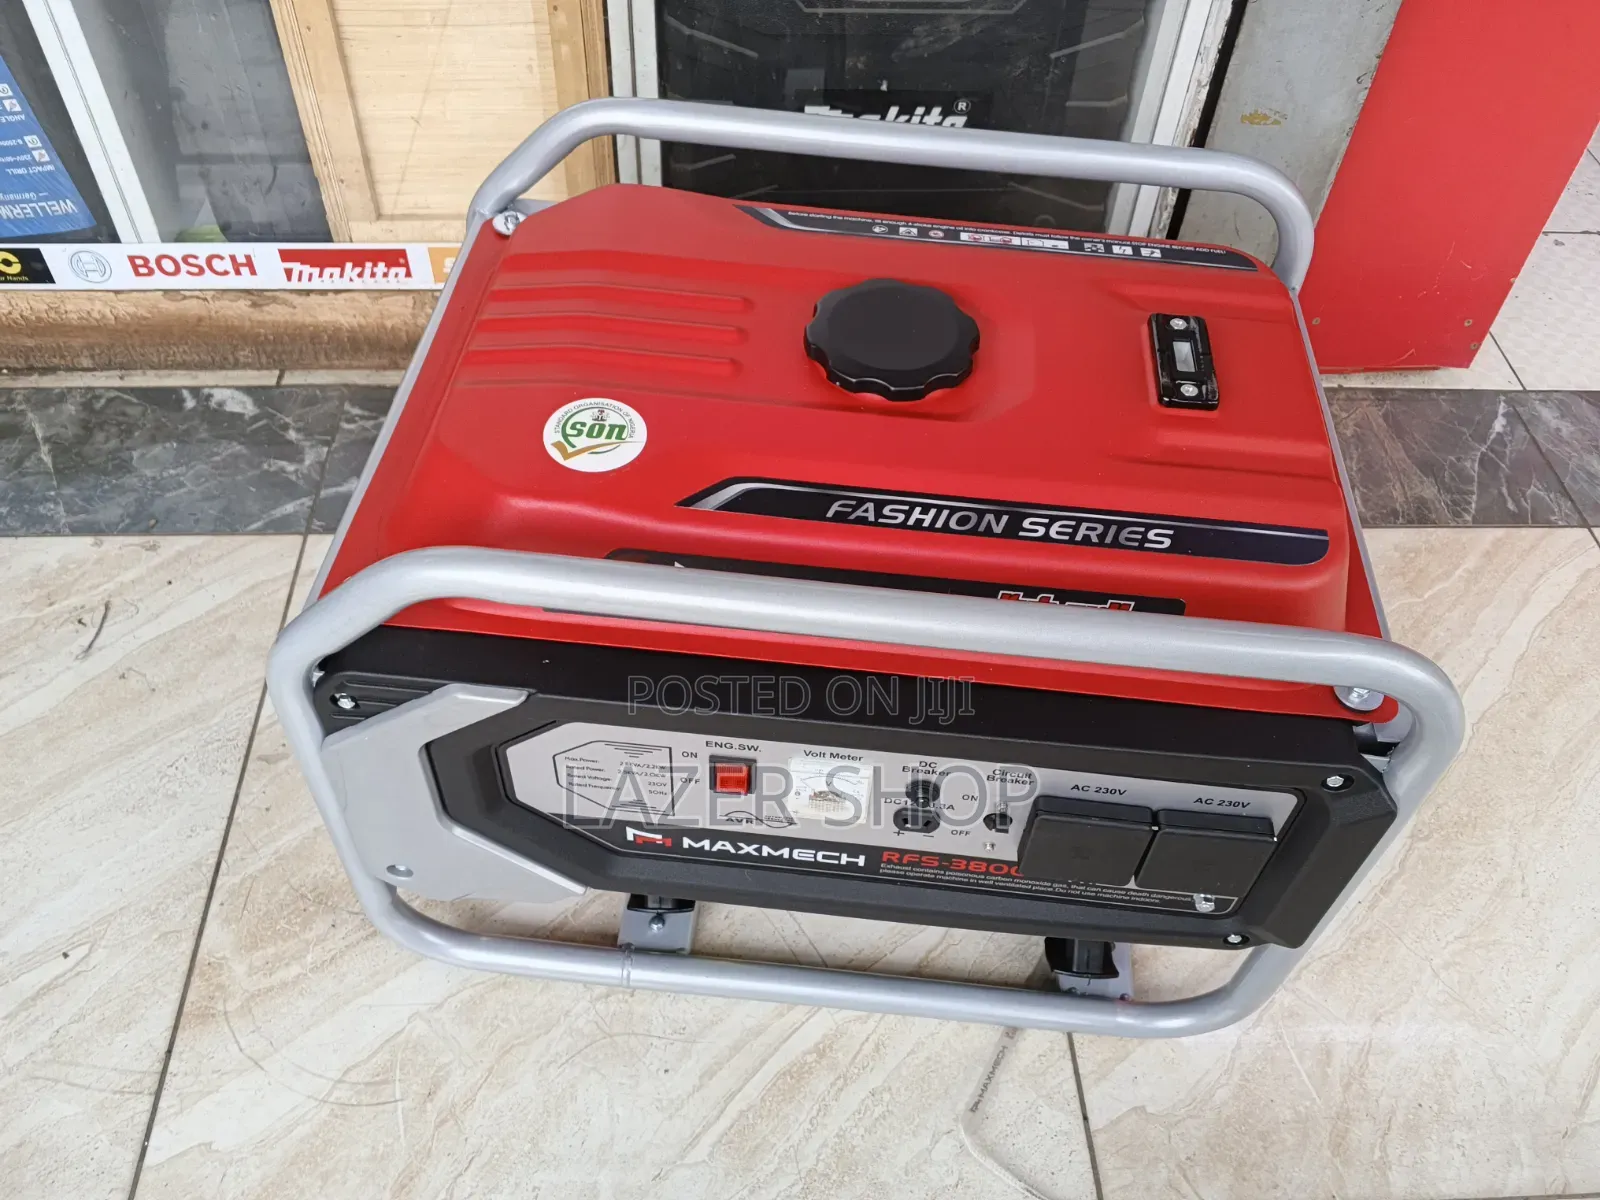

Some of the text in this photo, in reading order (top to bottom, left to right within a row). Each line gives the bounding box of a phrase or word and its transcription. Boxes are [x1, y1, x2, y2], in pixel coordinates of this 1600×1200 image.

[28, 164, 55, 173] IMPACT
[127, 254, 258, 277] BOSCH
[574, 401, 623, 413] ORGANISATION
[826, 500, 1174, 549] FASHION SERIES
[705, 740, 762, 752] ENG.SW.
[804, 750, 864, 762] Volt Meter
[918, 760, 938, 769] DC
[902, 766, 952, 777] Breaker
[992, 768, 1032, 779] Circuit
[680, 777, 701, 785] OFF
[986, 774, 1035, 786] Breaker
[1070, 784, 1127, 796] AC 230V
[962, 794, 979, 802] ON
[1217, 800, 1251, 809] 230V
[682, 836, 866, 867] MAXMECH
[880, 863, 912, 871] Exhaust
[912, 866, 944, 875] contains
[946, 870, 985, 880] poisonous
[986, 874, 1013, 882] carbon
[1014, 878, 1051, 886] monoxide
[1127, 890, 1150, 898] death
[880, 868, 904, 876] please
[936, 874, 968, 882] machine
[994, 881, 1030, 890] ventilated
[1097, 892, 1130, 900] machine
